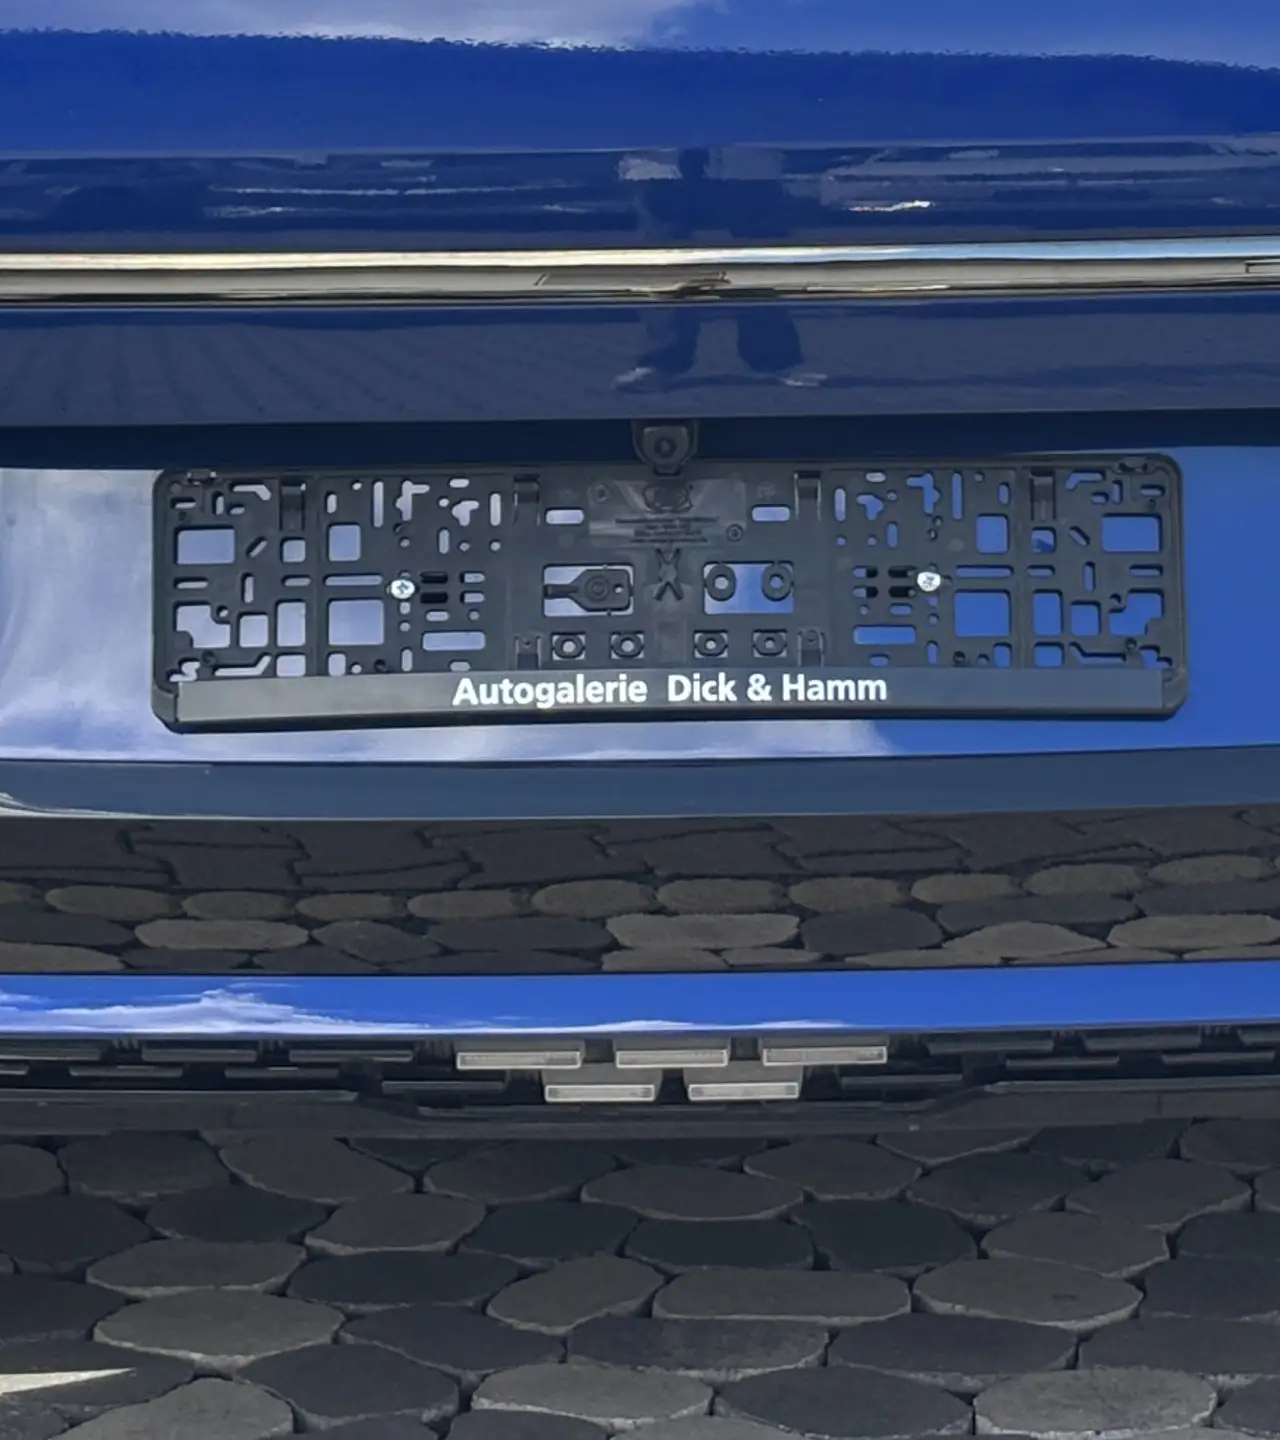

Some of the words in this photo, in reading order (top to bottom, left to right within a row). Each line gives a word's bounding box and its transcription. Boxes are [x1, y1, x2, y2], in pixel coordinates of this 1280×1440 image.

[452, 673, 648, 709] Autogalerie
[667, 672, 738, 702] Dick
[746, 673, 773, 702] &
[782, 673, 888, 702] Hamm
